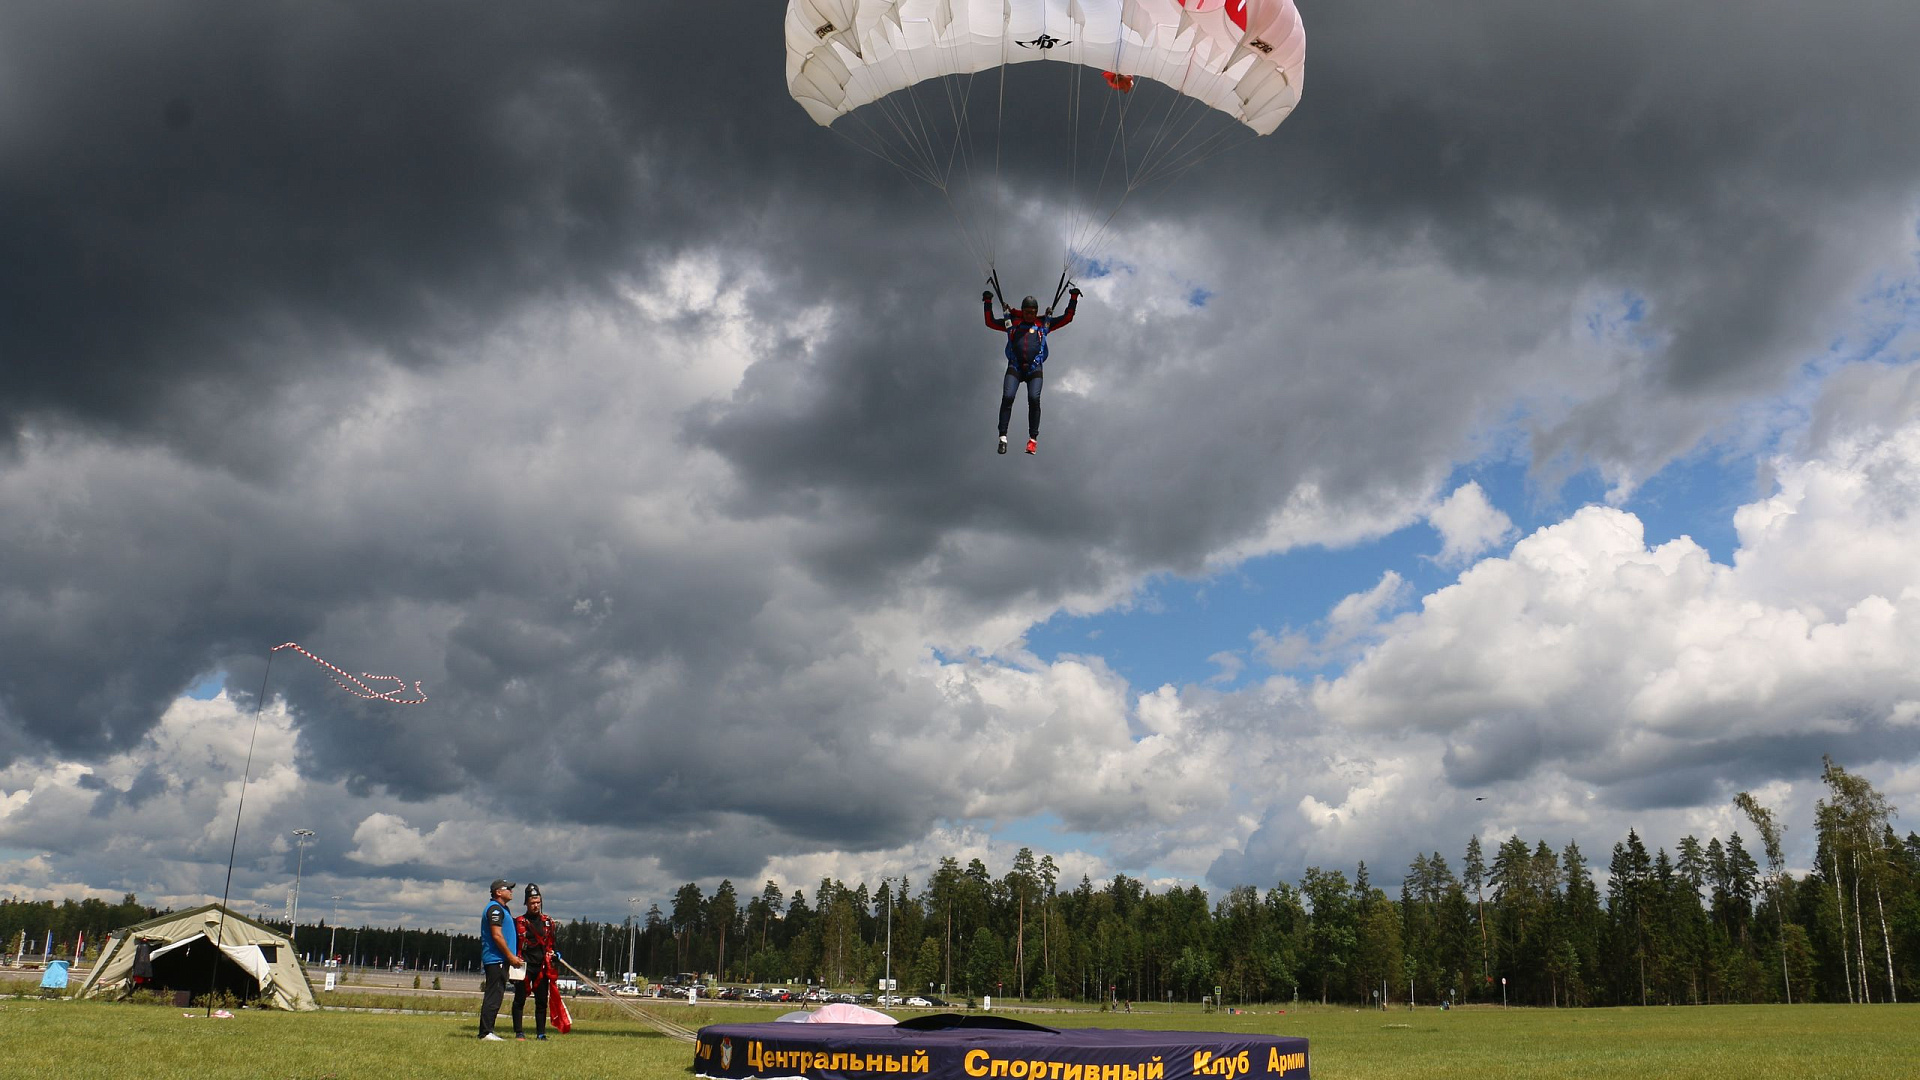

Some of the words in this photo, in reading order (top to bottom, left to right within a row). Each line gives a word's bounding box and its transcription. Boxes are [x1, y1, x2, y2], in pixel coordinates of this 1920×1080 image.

[747, 1041, 929, 1074] Центральный
[964, 1049, 1164, 1080] Спортивный
[1192, 1050, 1250, 1080] Клуб
[1267, 1046, 1305, 1077] Армии
